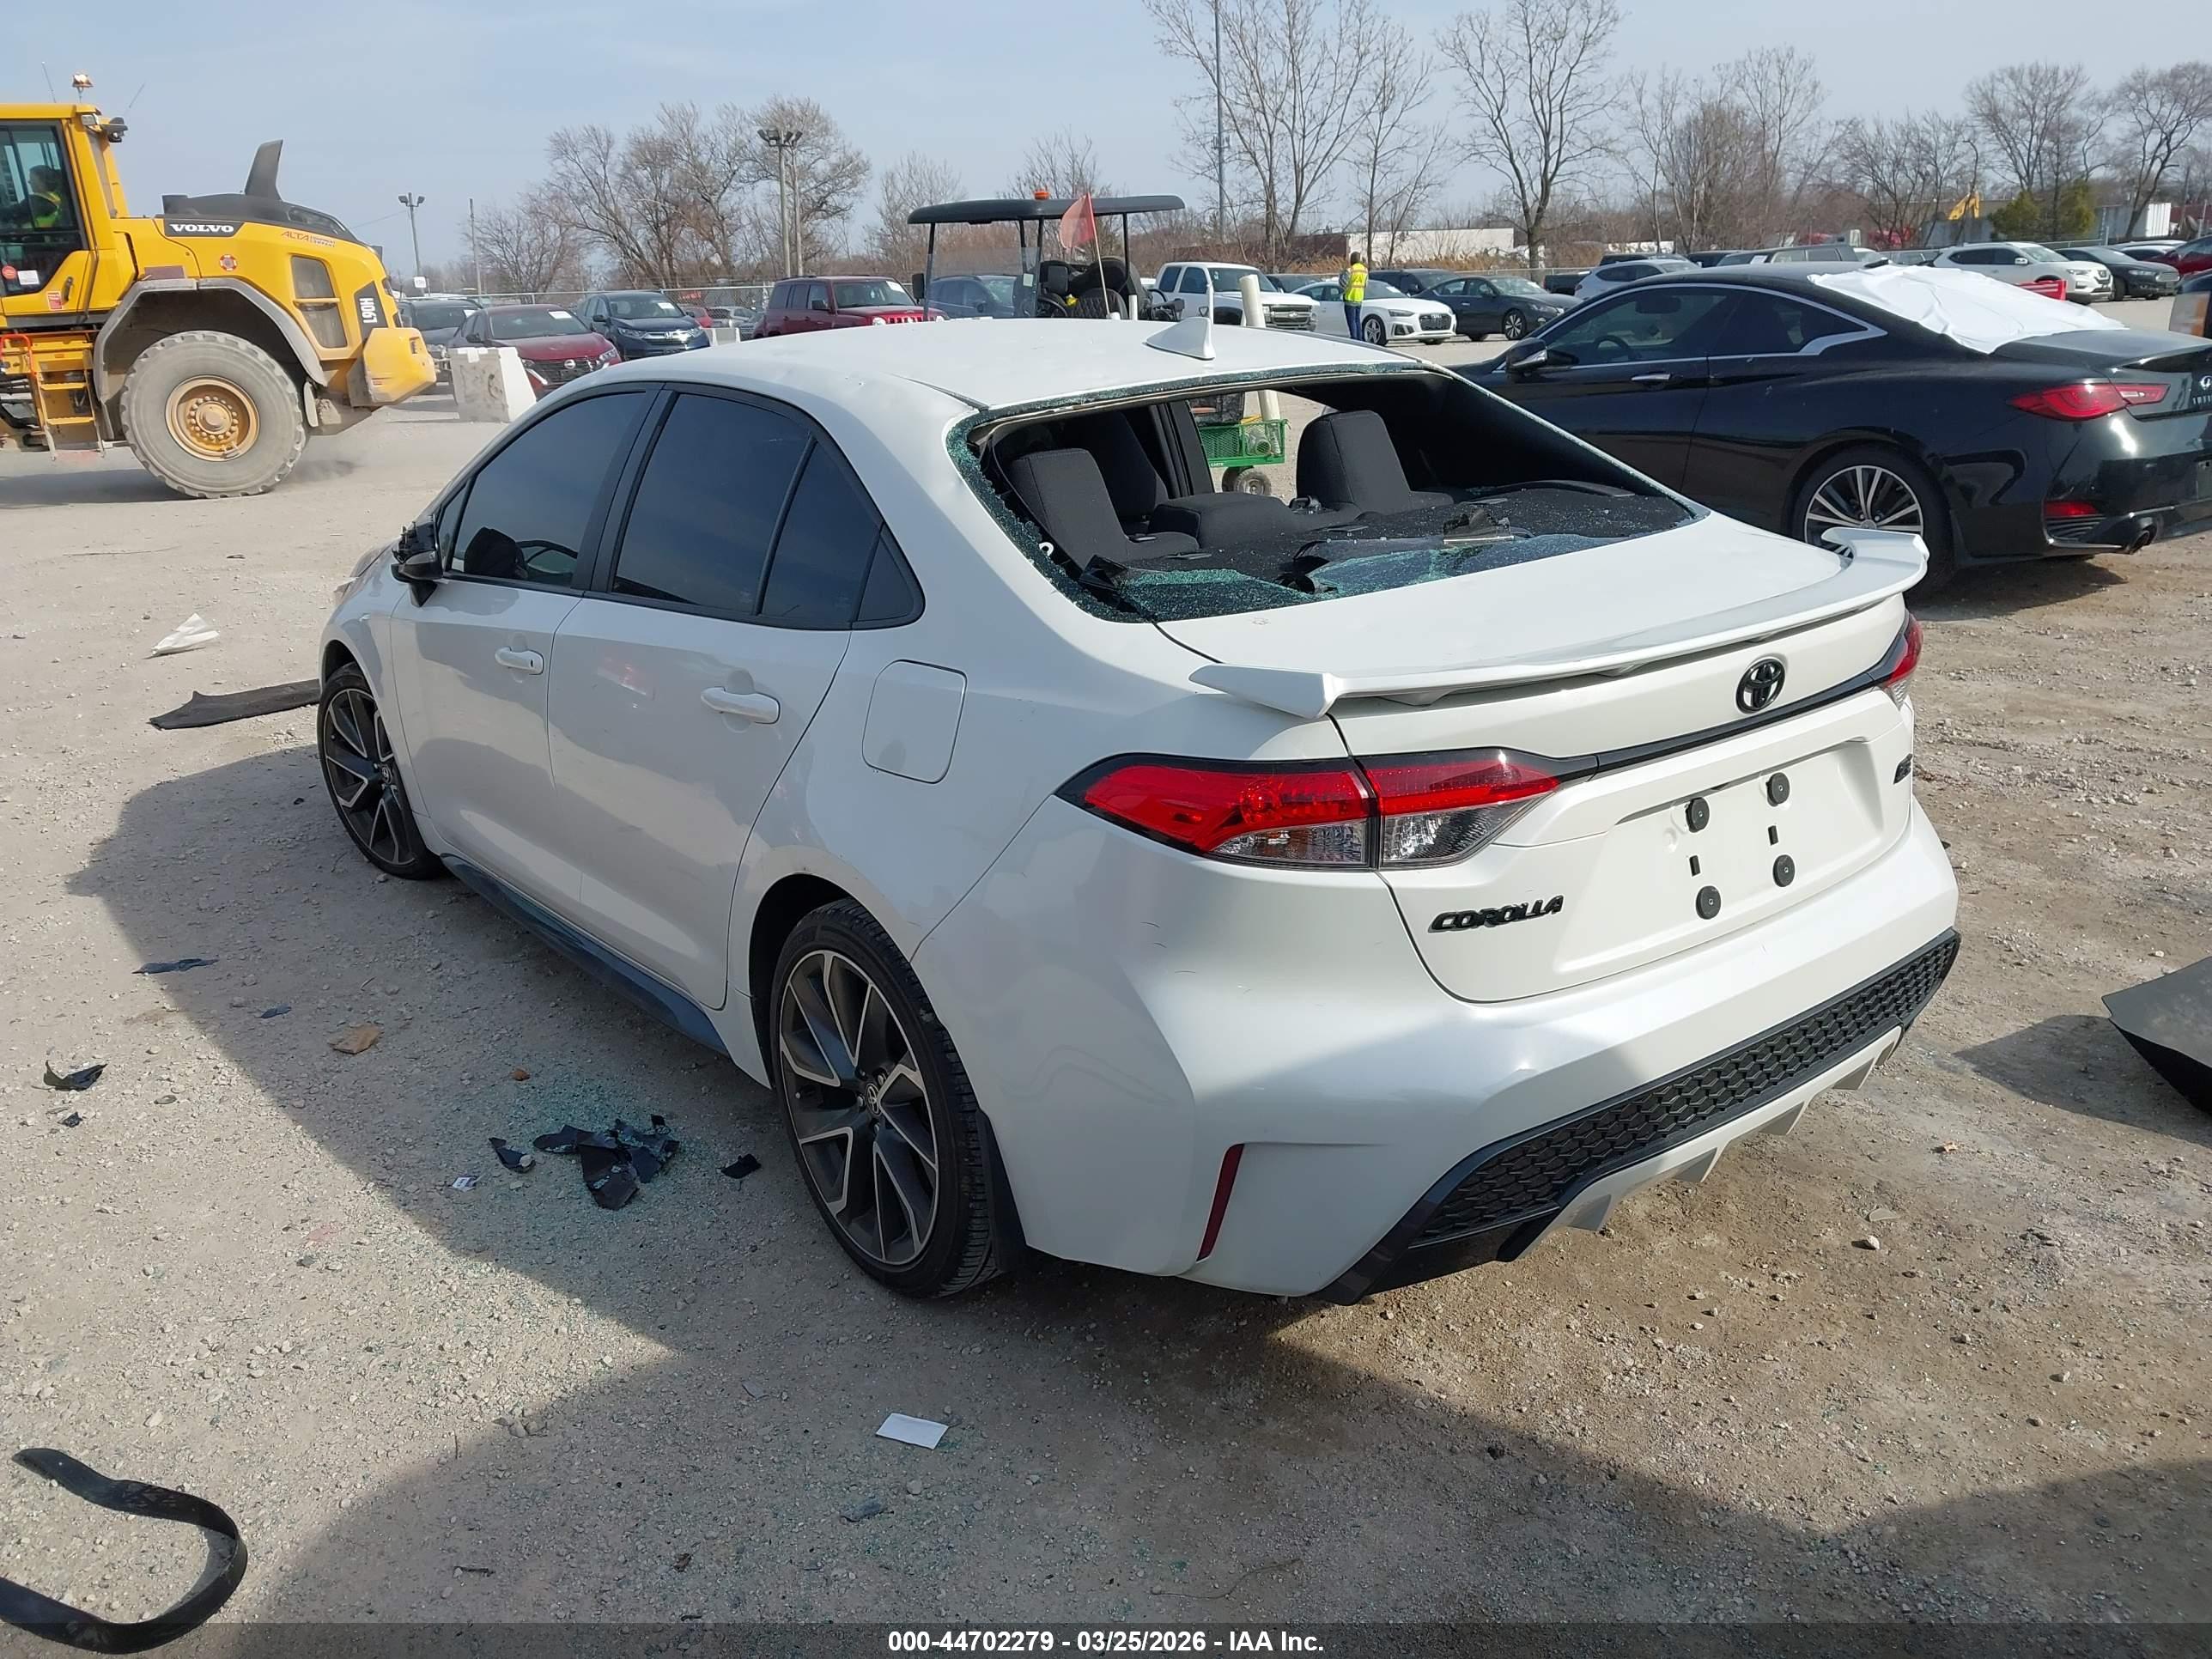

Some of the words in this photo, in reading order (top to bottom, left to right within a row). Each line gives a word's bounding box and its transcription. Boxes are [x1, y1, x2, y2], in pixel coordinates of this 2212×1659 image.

[169, 223, 234, 233] VOLVO
[359, 297, 378, 324] L90H
[1428, 895, 1565, 933] COROLLA
